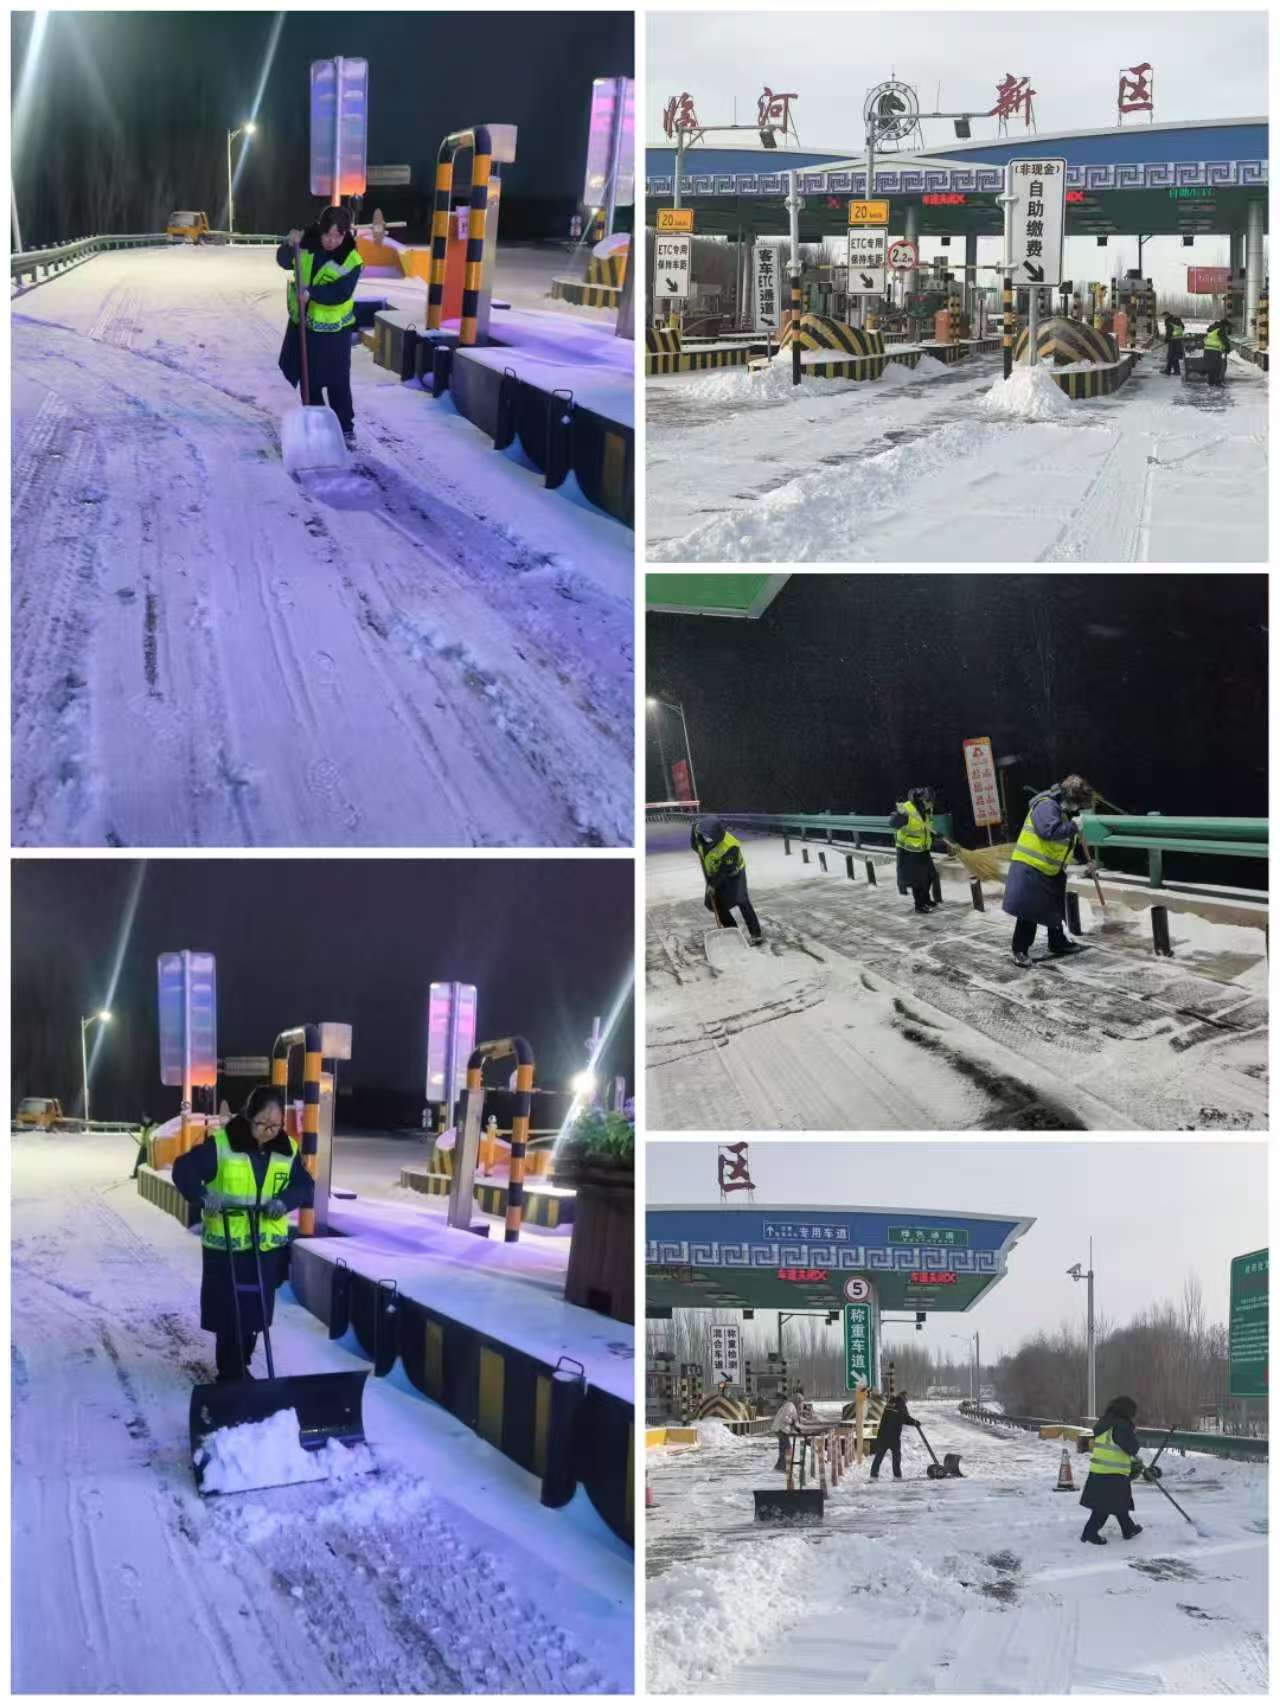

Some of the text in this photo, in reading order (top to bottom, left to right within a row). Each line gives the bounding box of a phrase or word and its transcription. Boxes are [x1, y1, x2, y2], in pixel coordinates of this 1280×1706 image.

[855, 206, 867, 219] 20
[1025, 179, 1045, 259] 自助缴费
[662, 214, 674, 227] 20
[658, 244, 688, 255] ETC专用
[850, 238, 884, 249] ETC专用
[657, 260, 688, 270] 保持车距
[850, 254, 884, 265] 保持车距
[757, 248, 776, 315] 客车ETC通道
[717, 1141, 756, 1192] 区
[799, 1225, 848, 1239] 专用车道
[851, 1282, 863, 1296] 5
[850, 1308, 867, 1369] 称重车道
